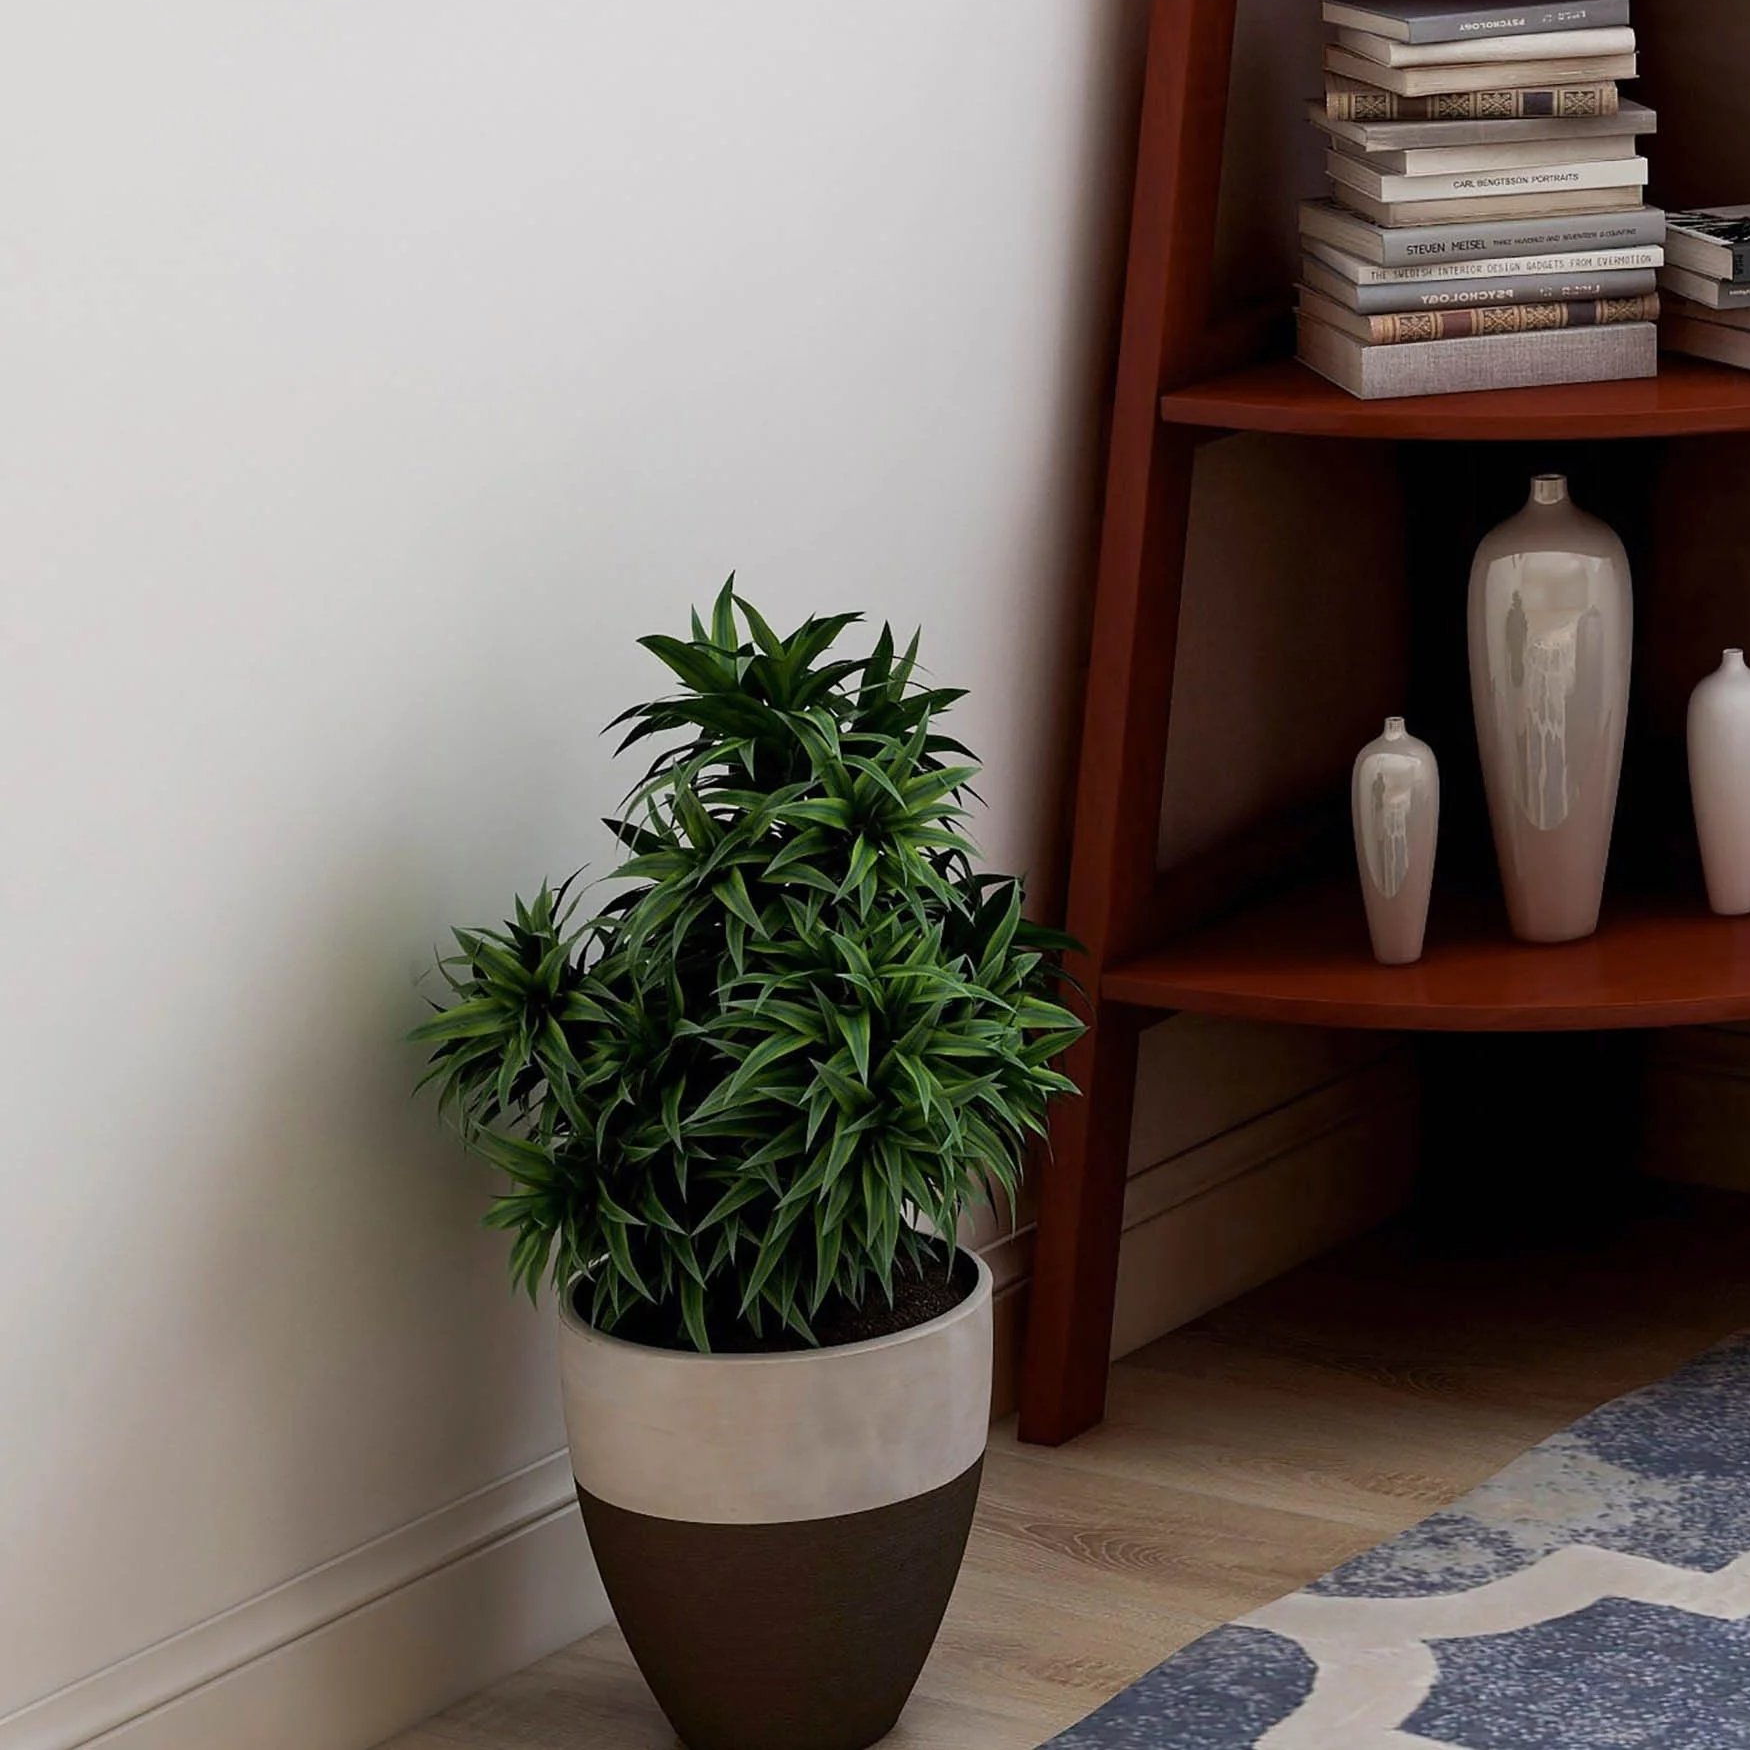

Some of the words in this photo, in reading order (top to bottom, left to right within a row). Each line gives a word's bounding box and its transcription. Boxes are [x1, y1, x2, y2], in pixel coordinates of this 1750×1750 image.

[1459, 17, 1526, 31] PSYCHOLOGY
[1453, 179, 1475, 189] CARL
[1476, 176, 1528, 187] BENGTSSON
[1531, 172, 1579, 184] PORTRAITS
[1406, 242, 1446, 256] STEVEN
[1451, 239, 1487, 251] MEISEL
[1371, 271, 1386, 280] THE
[1395, 267, 1432, 279] SWEDISH
[1439, 264, 1482, 276] INTERIOR
[1487, 262, 1520, 273] DESIGN
[1526, 259, 1564, 270] GADGETS
[1570, 257, 1593, 267] FROM
[1597, 254, 1651, 267] EVERMOTION
